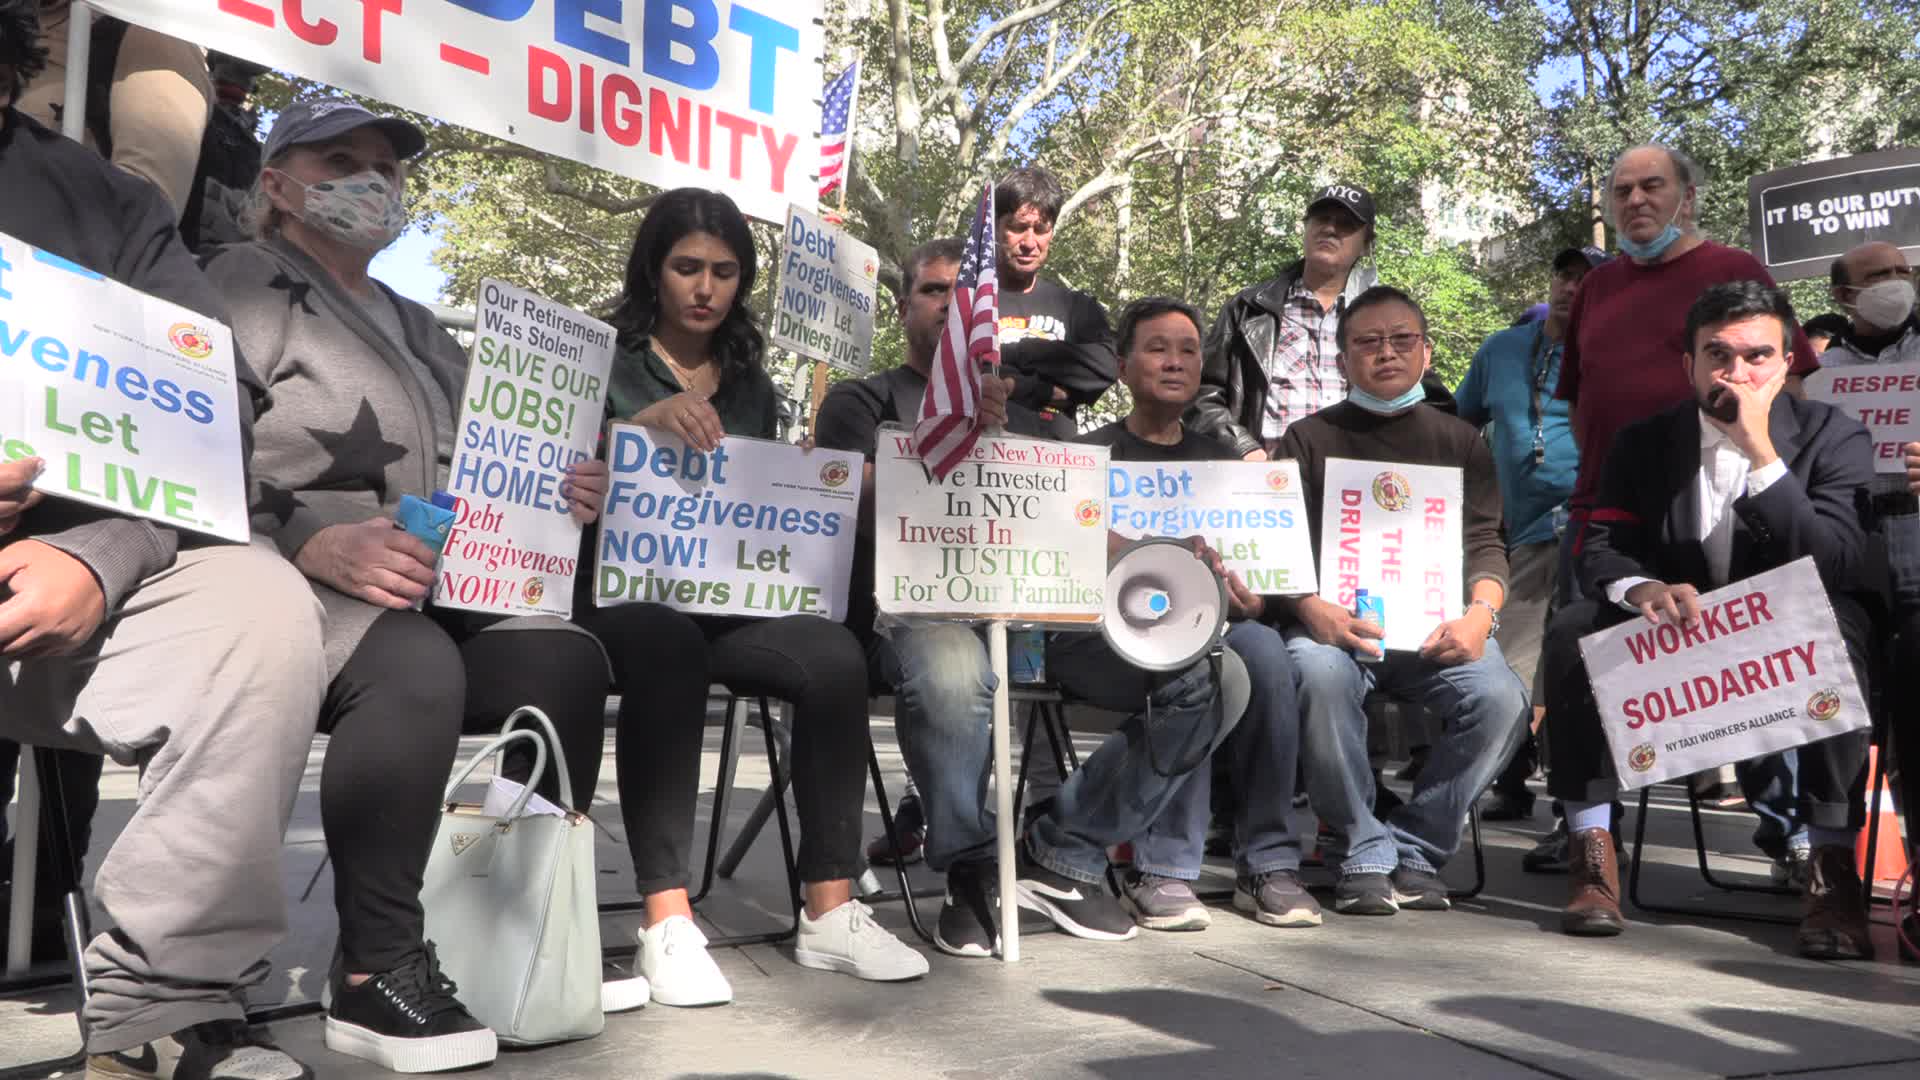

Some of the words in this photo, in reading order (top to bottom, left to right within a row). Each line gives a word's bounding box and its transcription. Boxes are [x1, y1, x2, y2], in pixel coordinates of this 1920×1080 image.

[444, 0, 799, 115] EBT
[528, 45, 799, 194] DIGNITY
[1326, 185, 1362, 203] NYC
[1766, 207, 1787, 226] IT
[1792, 202, 1814, 221] IS
[1818, 194, 1866, 216] OUR
[791, 216, 836, 264] Debt
[1809, 215, 1840, 236] TO
[1844, 208, 1890, 231] WIN
[786, 252, 871, 314] Forgiveness
[484, 284, 518, 313] Our
[523, 298, 611, 349] Retirement
[779, 312, 831, 353] Drivers
[782, 286, 827, 323] NOW!
[834, 306, 852, 335] Let
[484, 308, 522, 340] Was
[528, 326, 584, 363] Stolen!
[478, 336, 547, 384] SAVE
[551, 363, 602, 403] OUR
[1832, 374, 1920, 394] RESPE
[45, 386, 140, 455] Let
[469, 376, 576, 439] JOBS!
[1858, 408, 1911, 425] THE
[464, 420, 533, 463] SAVE
[612, 431, 729, 485] Debt
[991, 442, 1028, 461] New
[1033, 446, 1096, 468] Yorkers
[66, 452, 214, 528] LIVE.
[975, 464, 1067, 492] Invested
[1108, 467, 1193, 499] Debt
[452, 497, 504, 533] Debt
[606, 481, 841, 537] Forgiveness
[945, 492, 973, 517] In
[981, 494, 1040, 519] NYC
[1111, 504, 1294, 536] Forgiveness
[442, 528, 576, 577] Forgiveness
[602, 529, 709, 569] NOW!
[736, 540, 792, 574] Let
[897, 516, 978, 544] Invest
[986, 519, 1012, 545] In
[1216, 537, 1260, 561] Let
[1338, 489, 1362, 614] DRIVERS
[936, 548, 1070, 580] JUSTICE
[1382, 528, 1403, 584] THE
[437, 571, 515, 609] NOW!
[599, 565, 731, 606] Drivers
[894, 575, 938, 601] For
[946, 576, 1003, 602] Our
[1012, 578, 1104, 605] Families
[1624, 591, 1774, 665] WORKER
[1622, 641, 1817, 730] SOLIDARITY
[1665, 740, 1677, 752] NY
[1677, 735, 1699, 750] TAXI
[1699, 721, 1748, 743] WORKERS
[1748, 707, 1797, 730] ALLIANCE
